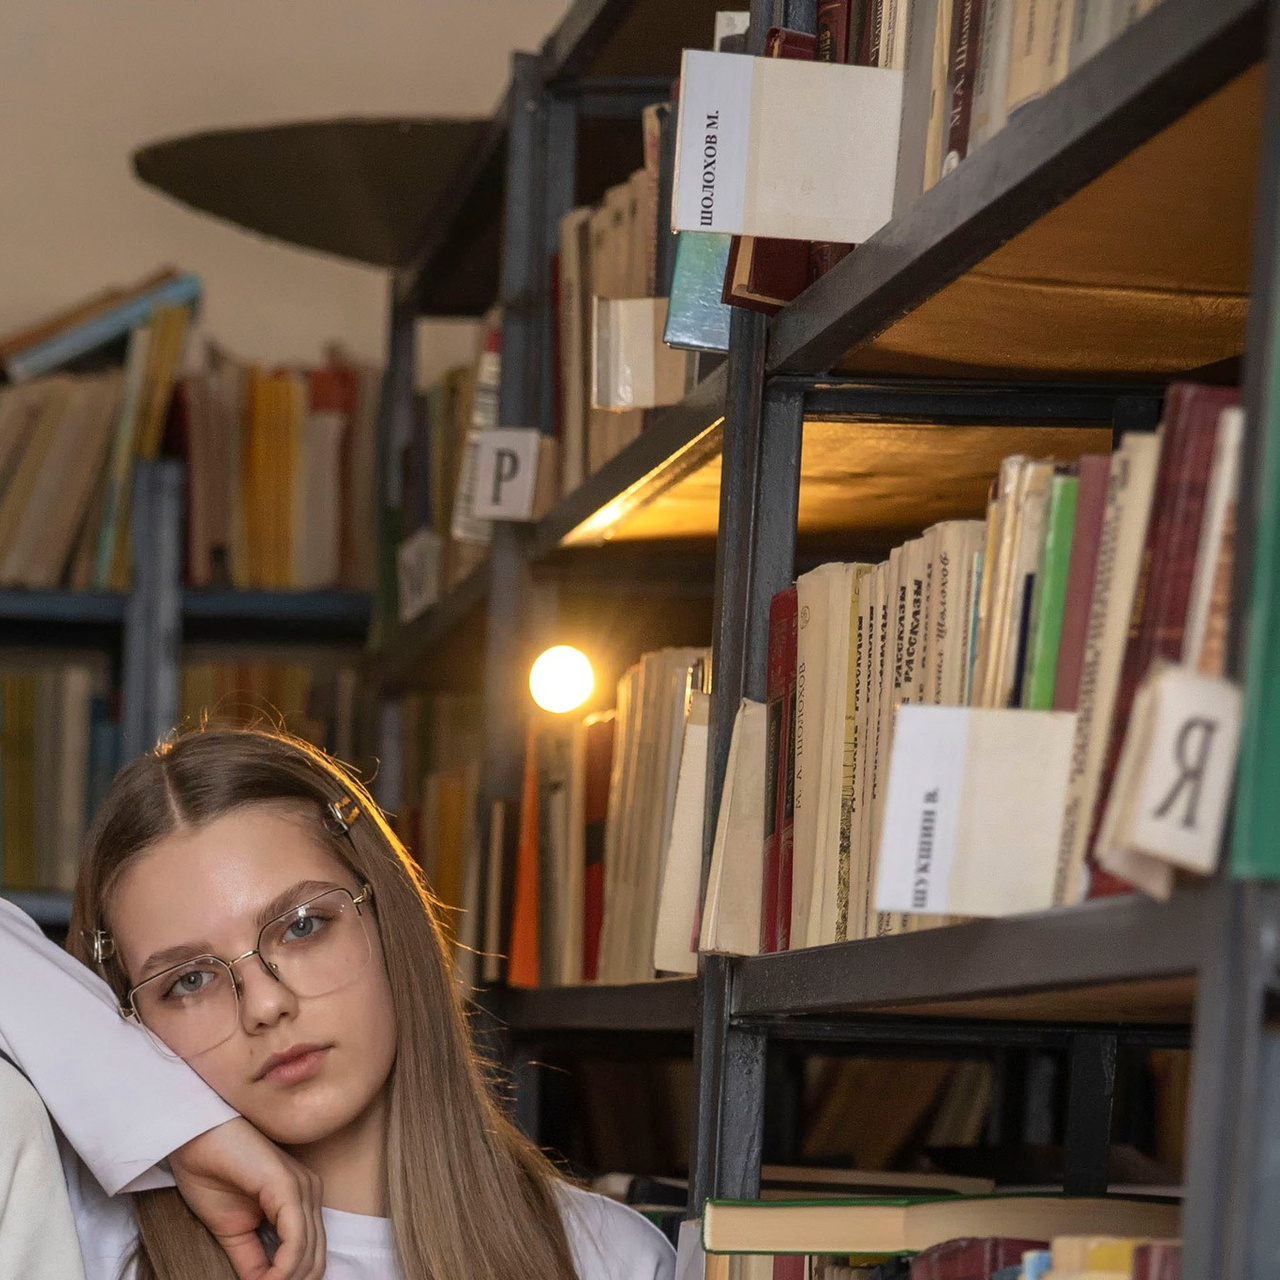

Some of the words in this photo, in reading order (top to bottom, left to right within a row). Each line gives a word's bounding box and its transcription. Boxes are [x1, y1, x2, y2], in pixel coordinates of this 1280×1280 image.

[705, 110, 720, 130] М.
[700, 134, 718, 226] ШОЛОХОВ
[491, 448, 521, 507] Р
[894, 585, 907, 689] РАССКАЗЫ
[903, 579, 923, 684] РАССКАЗЫ
[795, 661, 807, 757] ШОЛОХОВ
[1153, 717, 1218, 829] Я
[912, 809, 938, 909] ШУКШИН
